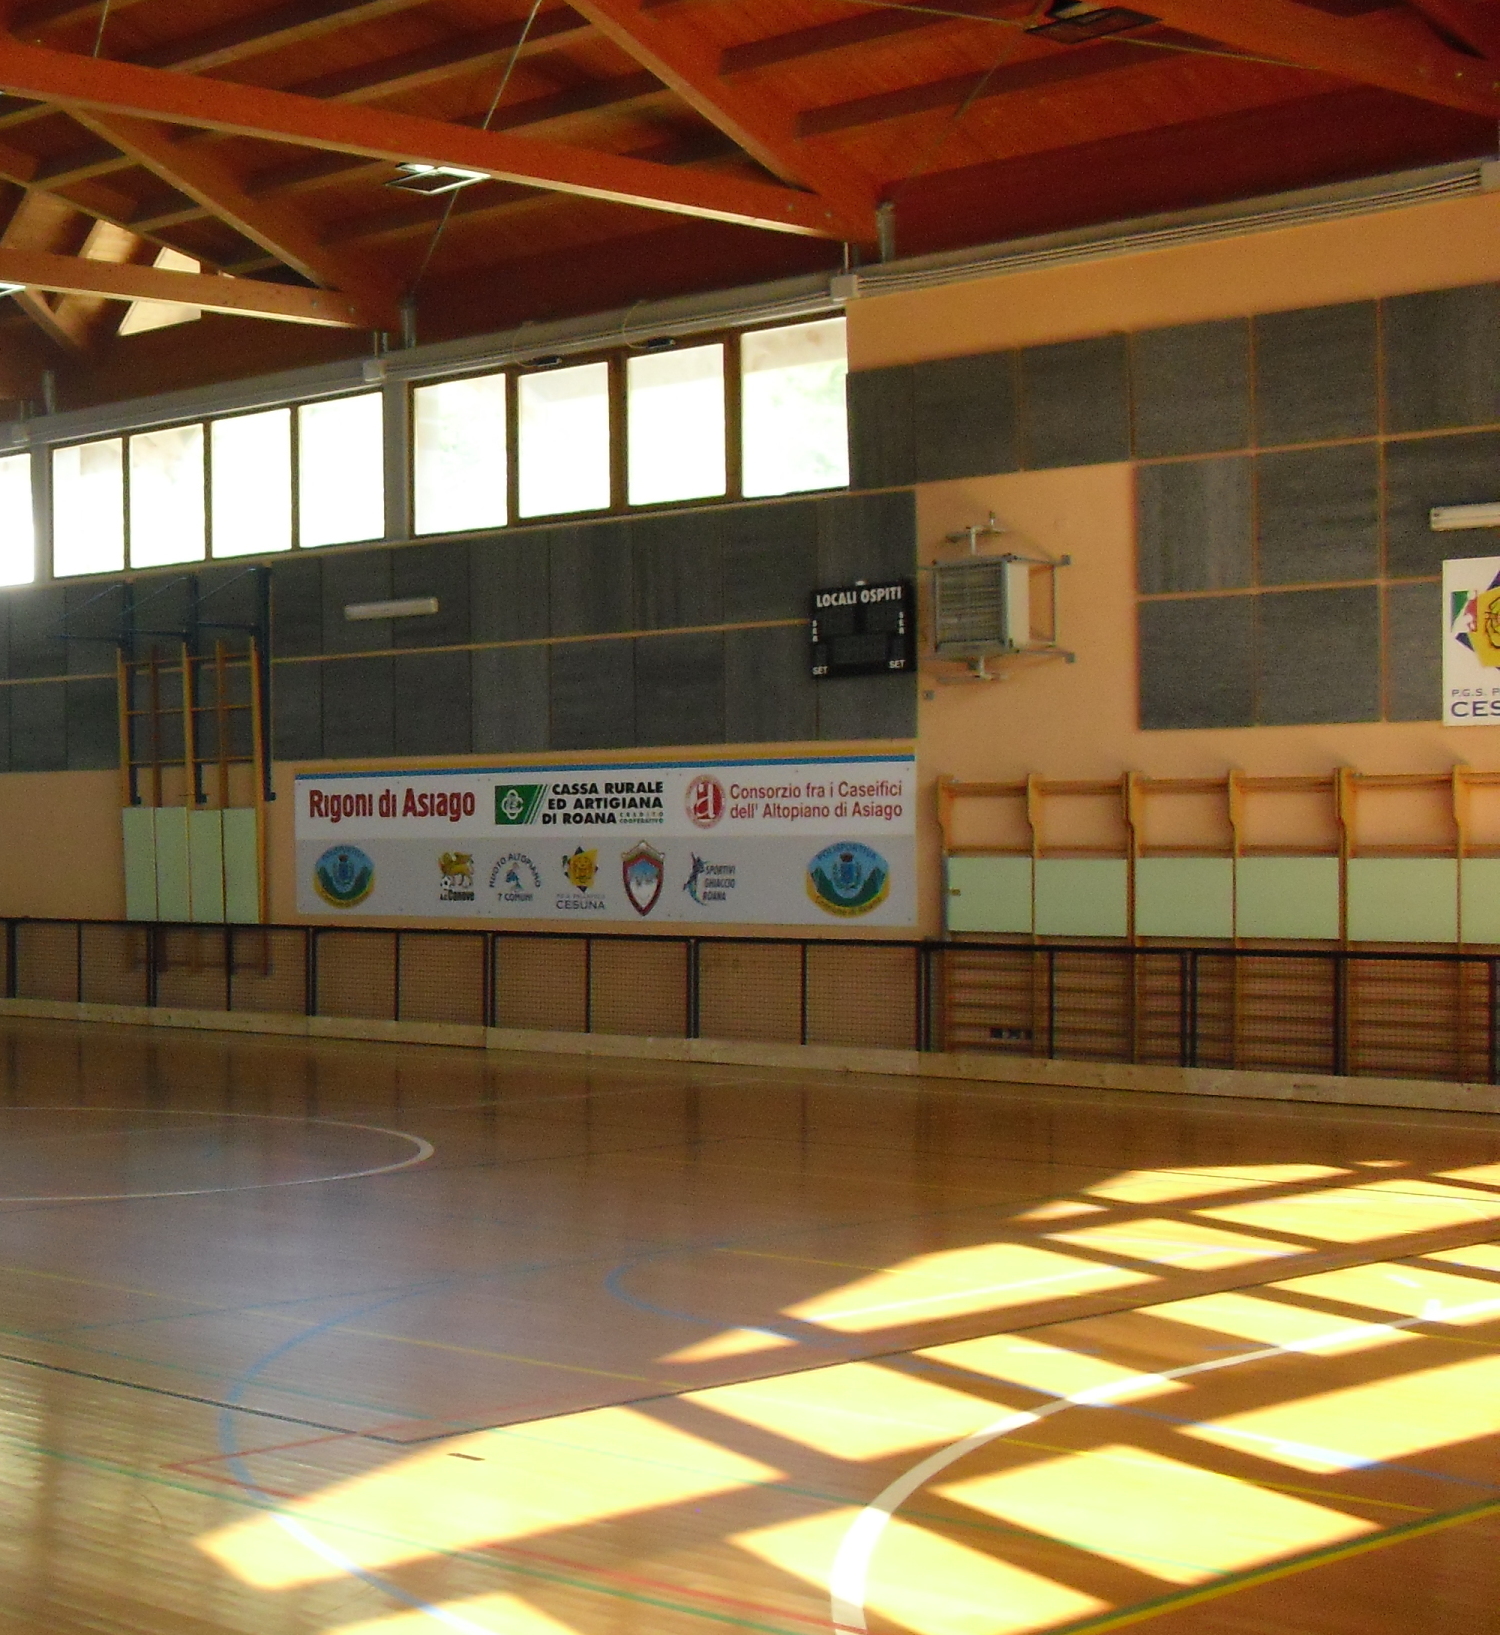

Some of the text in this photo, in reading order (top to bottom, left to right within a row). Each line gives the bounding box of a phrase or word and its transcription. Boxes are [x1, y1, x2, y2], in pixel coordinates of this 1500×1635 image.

[816, 586, 902, 608] LOCALI OSPITI
[812, 665, 829, 675] SET
[888, 659, 906, 669] SET
[1451, 688, 1487, 697] P.G.S.
[552, 781, 664, 795] CASSA RURALE
[730, 780, 903, 799] Consorzio fra i Caseifici
[309, 788, 476, 823] Rigoni di Asiago
[548, 796, 664, 810] ED ARTIGIANA
[730, 801, 903, 821] dell' Altopiano di Asiago
[542, 812, 617, 825] DI ROANA
[489, 857, 507, 888] NUOTO
[706, 865, 736, 875] SPORTIVI
[702, 891, 727, 901] ROANA
[556, 900, 606, 910] CESUNA
